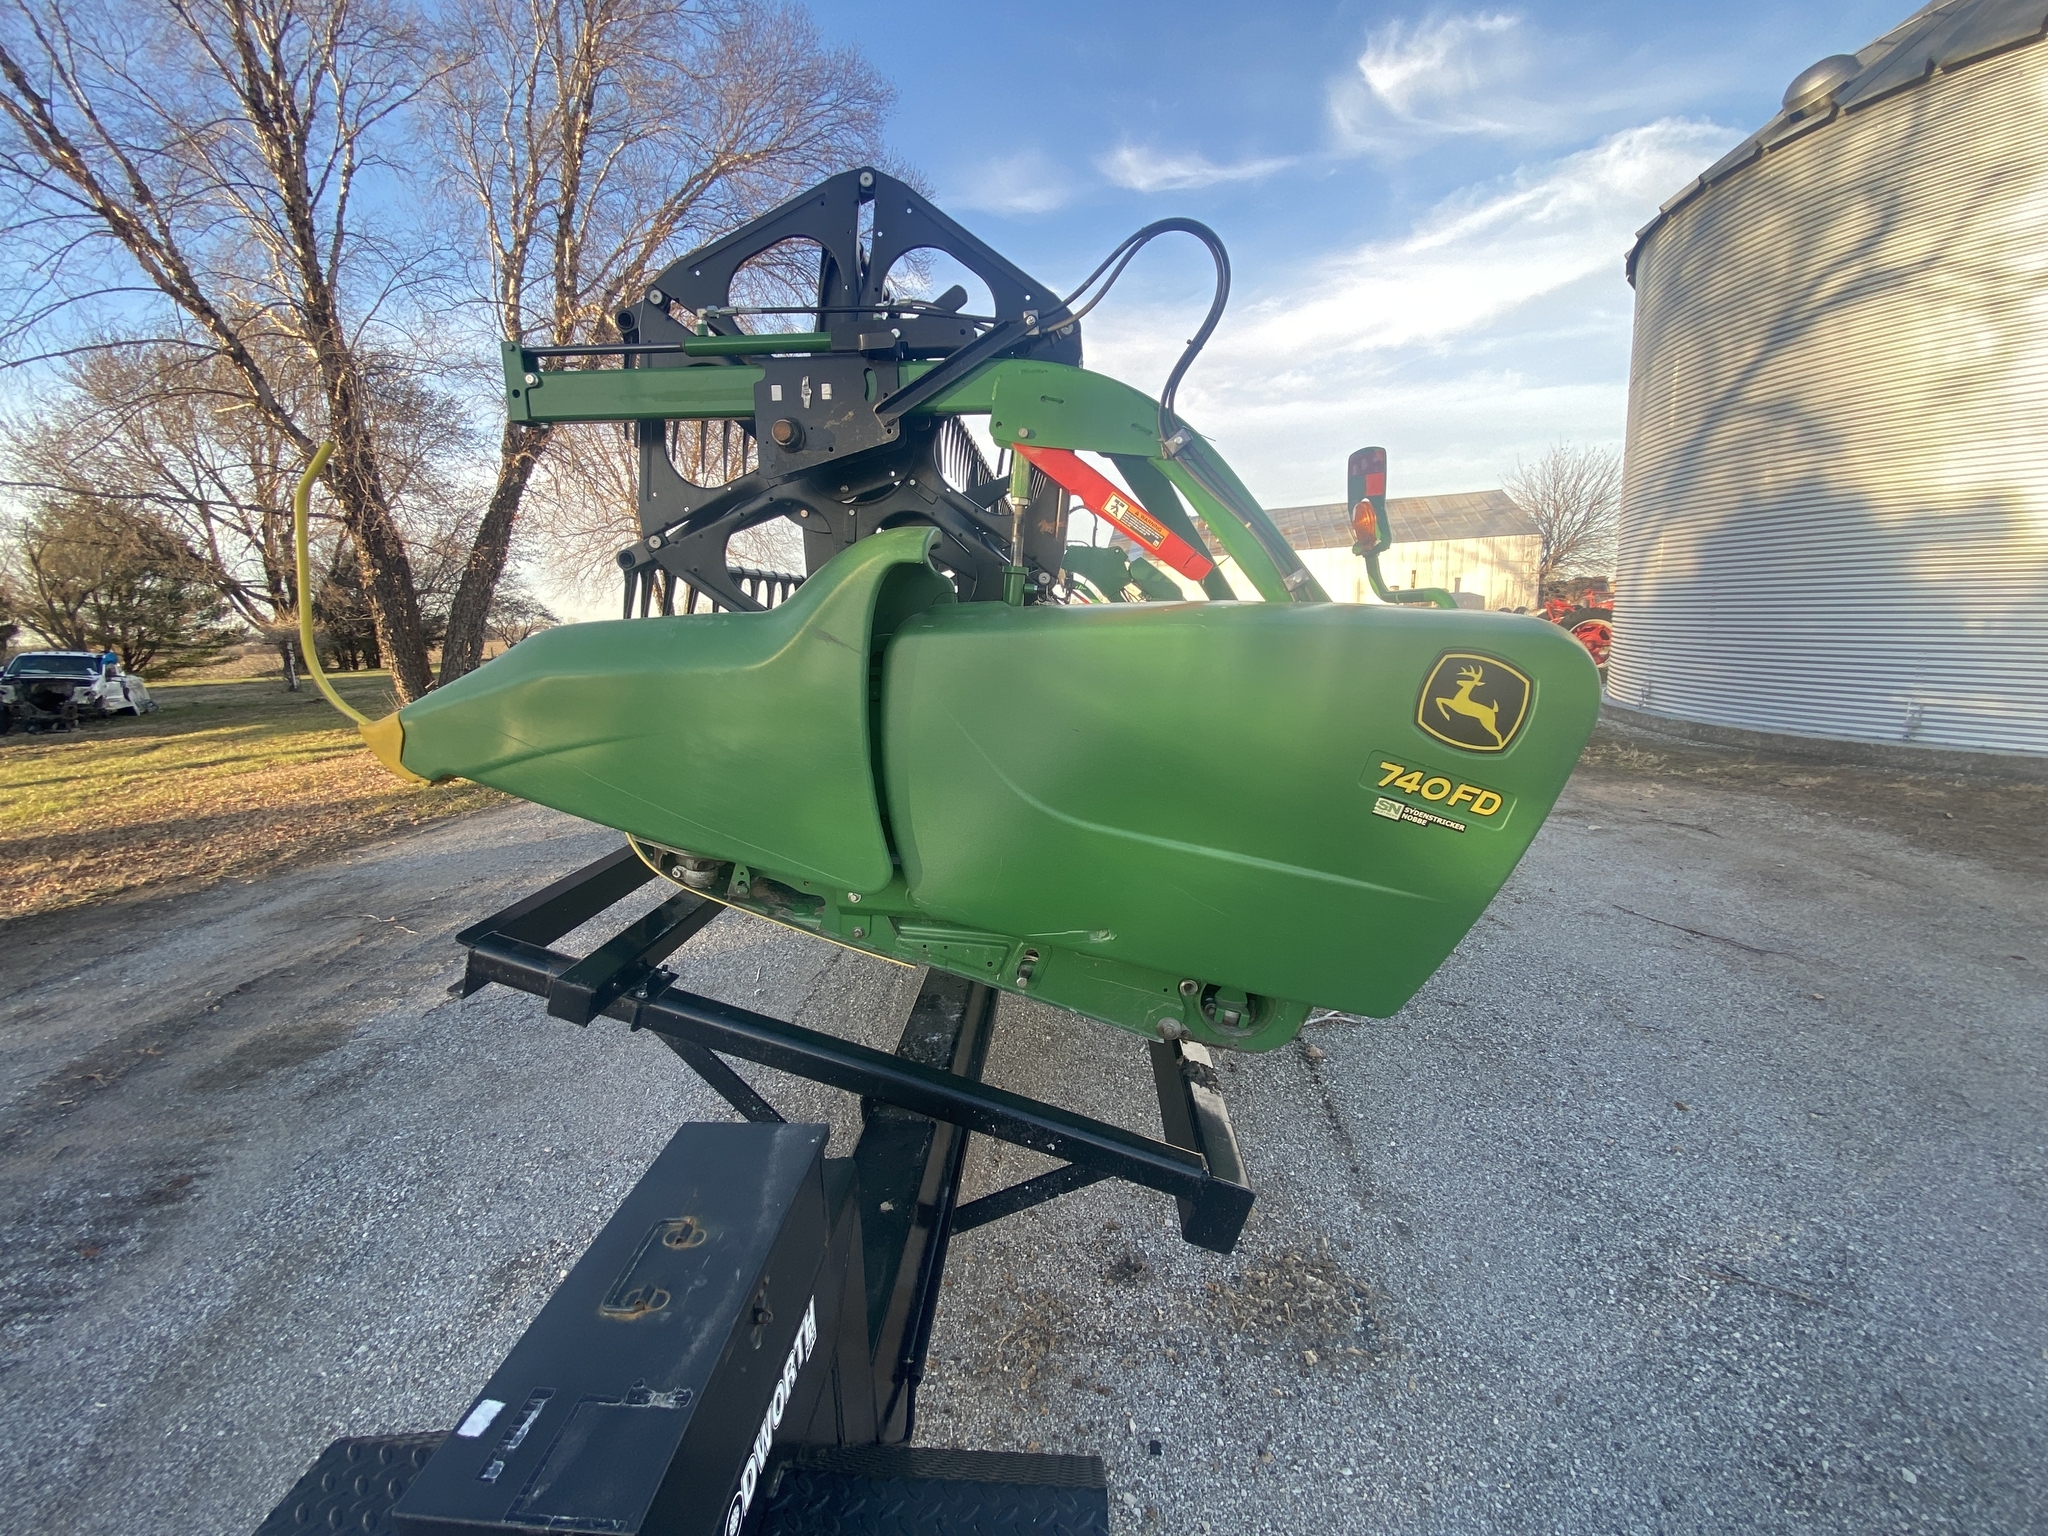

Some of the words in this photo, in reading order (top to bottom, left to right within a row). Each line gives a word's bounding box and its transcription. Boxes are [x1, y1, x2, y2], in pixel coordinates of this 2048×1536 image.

[1141, 514, 1163, 533] WARNING
[1378, 761, 1503, 816] 740FD
[1375, 800, 1402, 815] SN
[1401, 813, 1428, 826] NOBBE
[1403, 806, 1466, 832] SYDENSTRICKER
